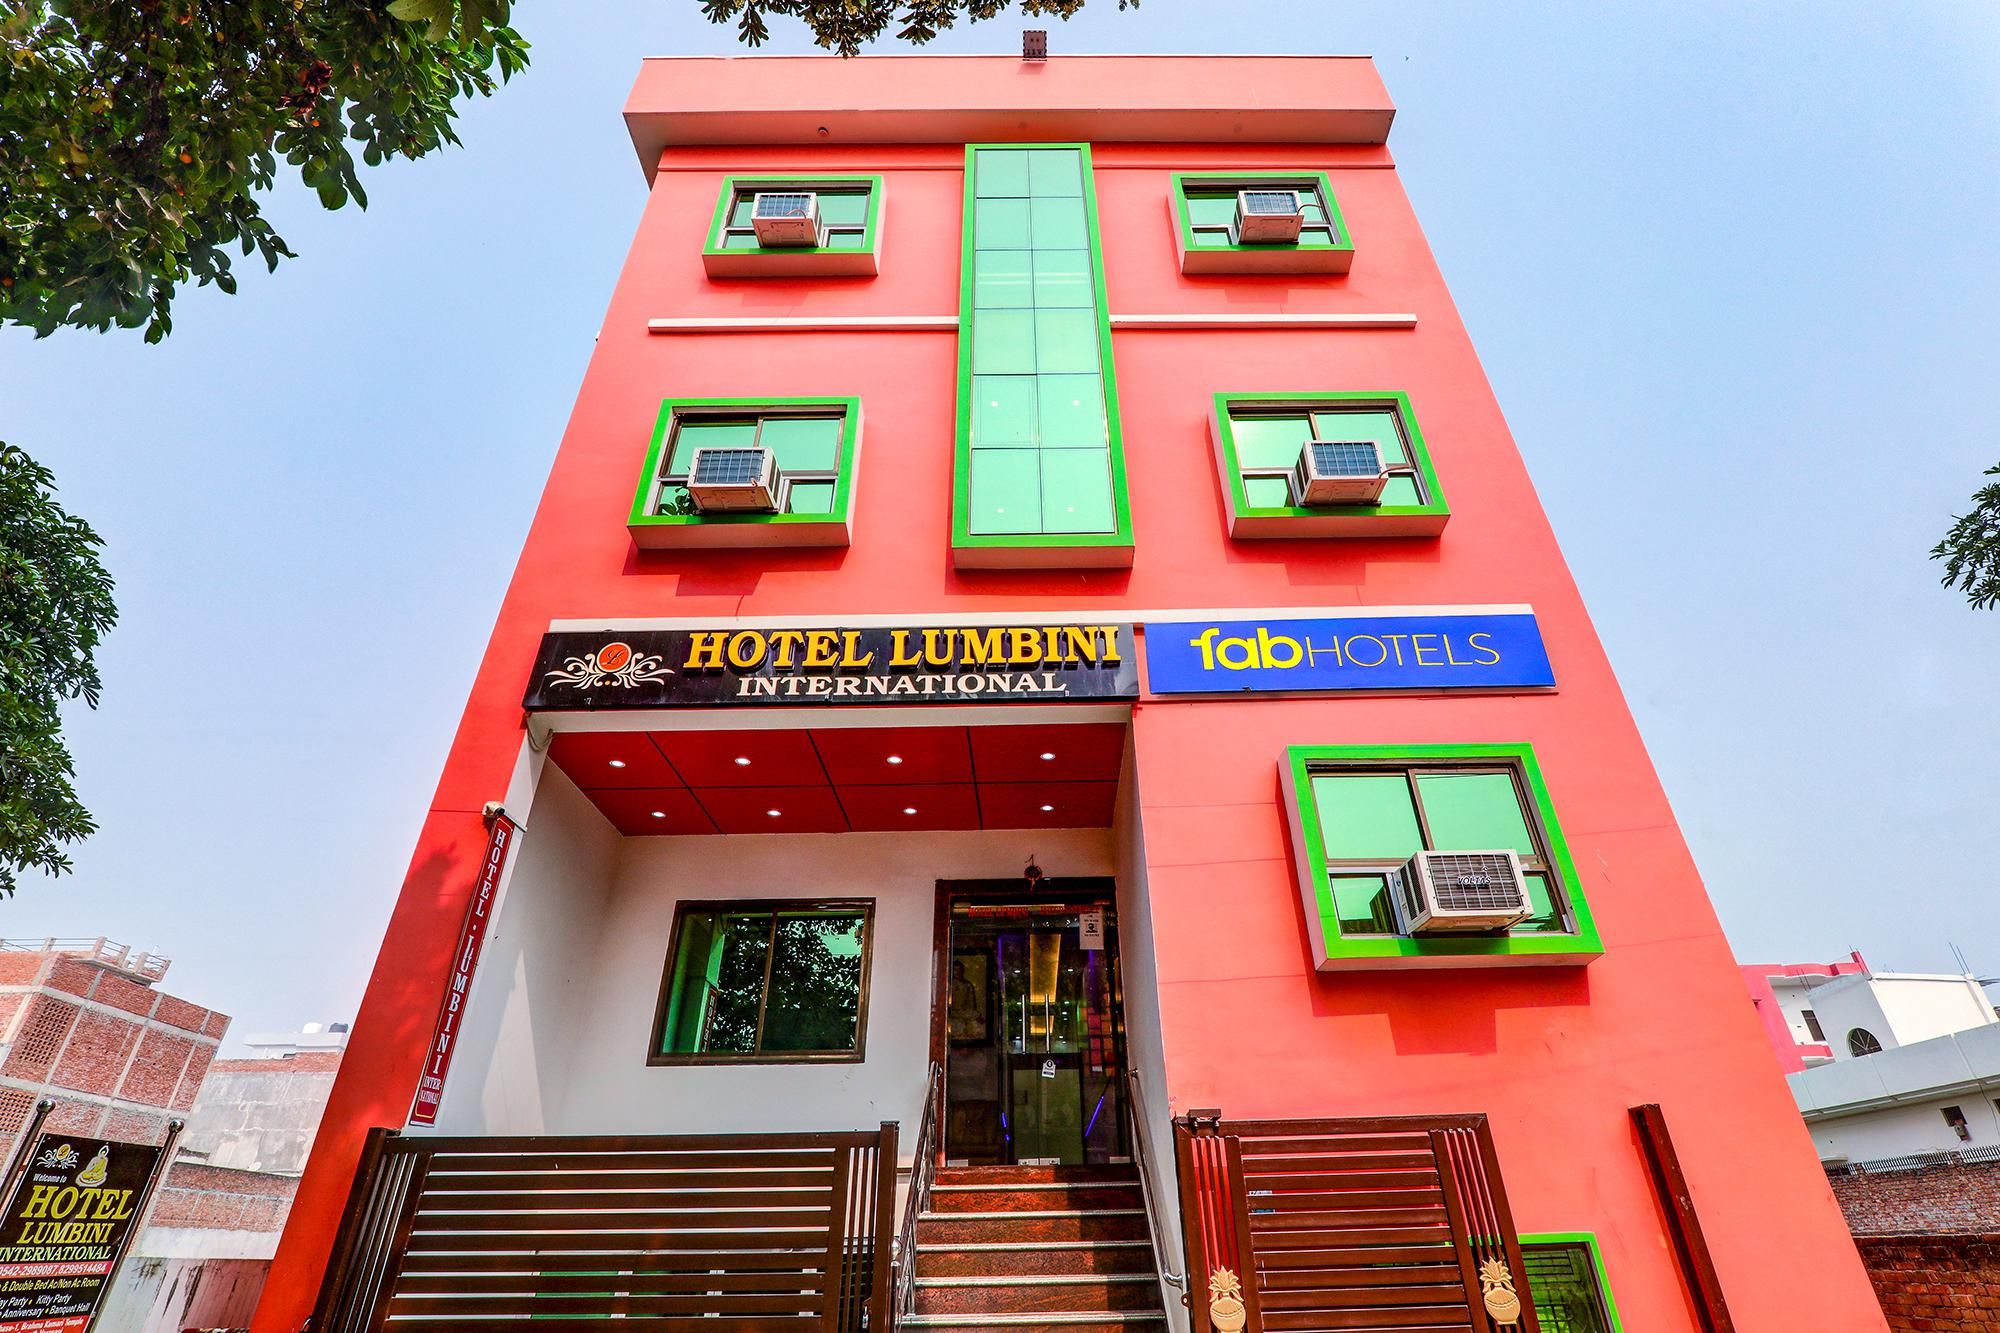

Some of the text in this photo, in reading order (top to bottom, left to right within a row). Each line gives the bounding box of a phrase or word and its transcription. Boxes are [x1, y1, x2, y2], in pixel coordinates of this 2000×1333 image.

[683, 626, 1122, 670] HOTEL LUMBINI
[736, 672, 1067, 696] INTERNATIONAL
[1457, 876, 1491, 885] VOLTAS
[432, 828, 507, 1075] HOTEL LUMBINI
[33, 1173, 67, 1184] Welcome to
[19, 1185, 133, 1220] HOTEL
[16, 1221, 115, 1245] LUMBINI
[8, 1280, 34, 1291] Double
[33, 1279, 50, 1290] Bed
[80, 1277, 101, 1288] Room
[8, 1296, 29, 1308] Party
[36, 1294, 55, 1306] Kitty
[52, 1293, 73, 1305] Party
[1, 1307, 45, 1318] Anniversary
[49, 1303, 77, 1315] Banquet
